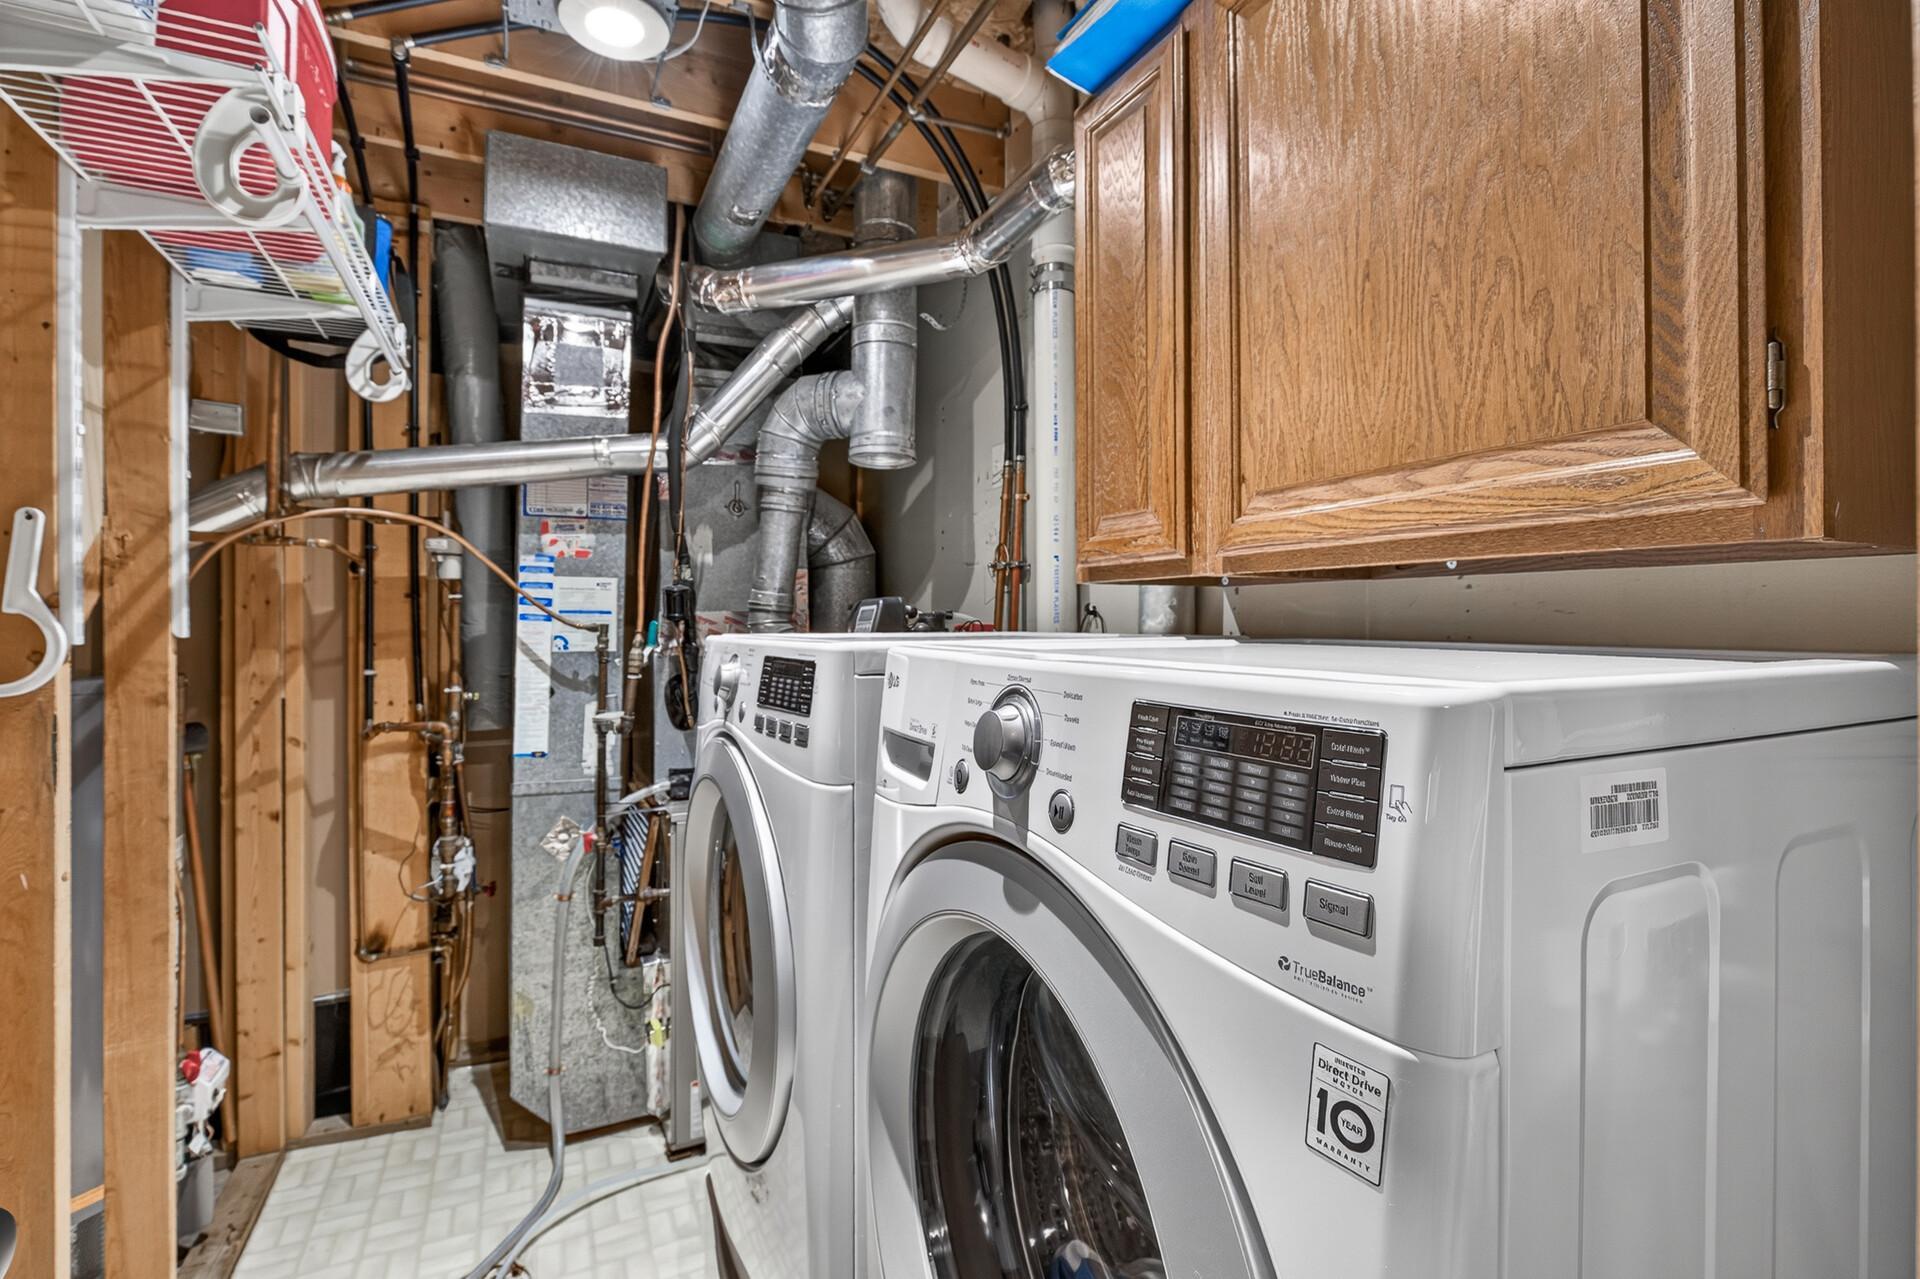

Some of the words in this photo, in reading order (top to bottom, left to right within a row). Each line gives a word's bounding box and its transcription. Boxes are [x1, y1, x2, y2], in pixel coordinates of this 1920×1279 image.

[1326, 807, 1345, 816] Extra
[1182, 851, 1198, 865] Spin
[1178, 862, 1200, 876] Speed
[1248, 872, 1264, 885] Soil
[1245, 883, 1266, 898] Level
[1319, 897, 1349, 916] Signal
[1318, 1057, 1348, 1081] Direct
[1352, 1074, 1382, 1097] Drive
[1332, 1077, 1363, 1096] MOTOR
[1316, 1087, 1375, 1153] 10
[1340, 1116, 1363, 1137] YEAR
[1316, 1137, 1370, 1172] WARRANTY
